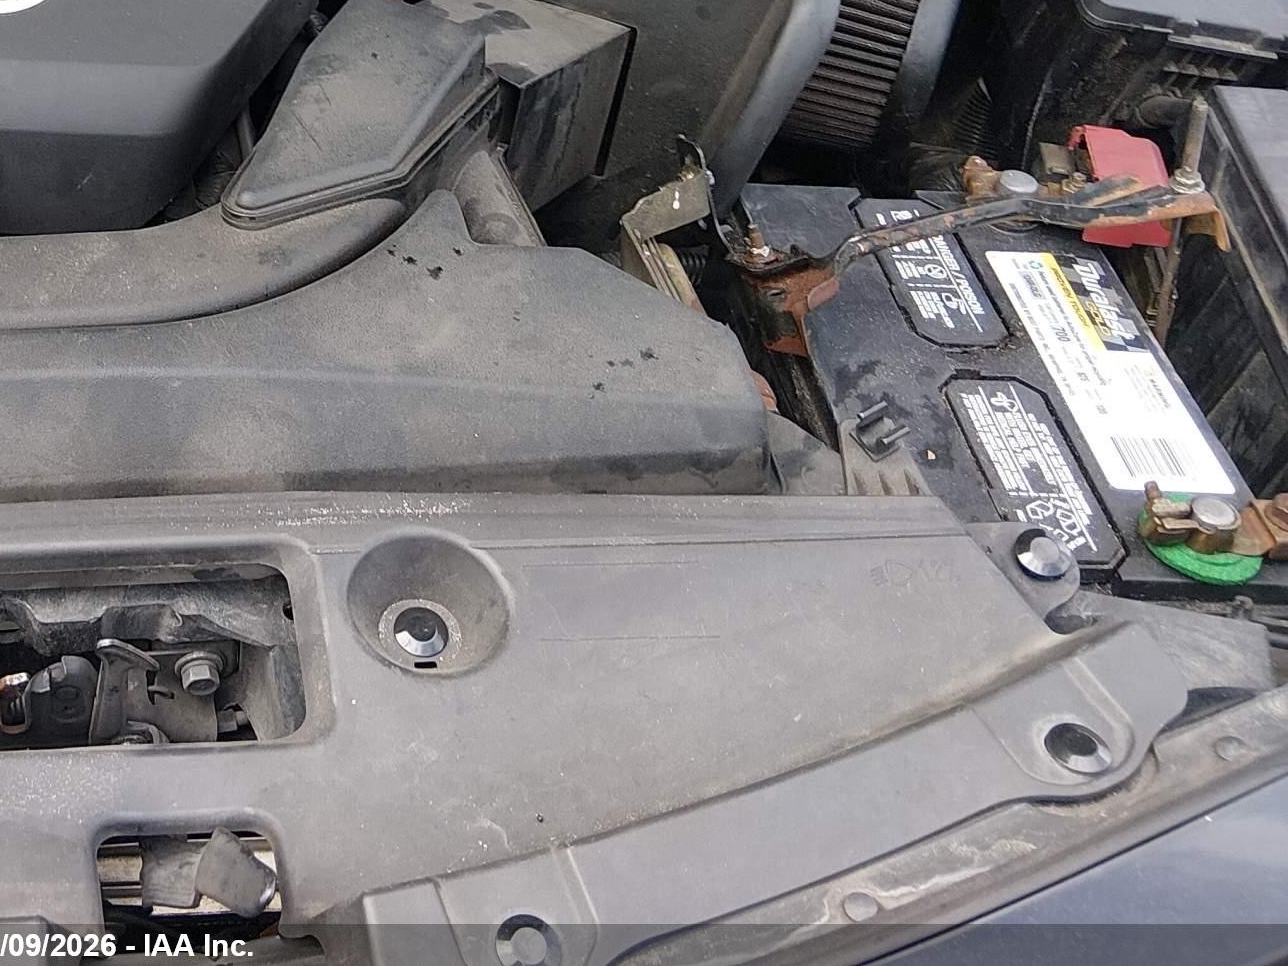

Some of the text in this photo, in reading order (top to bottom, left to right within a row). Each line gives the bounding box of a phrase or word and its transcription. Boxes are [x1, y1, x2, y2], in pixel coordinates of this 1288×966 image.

[955, 277, 985, 314] POISON
[1071, 262, 1136, 339] Duralast
[1050, 325, 1071, 342] 700
